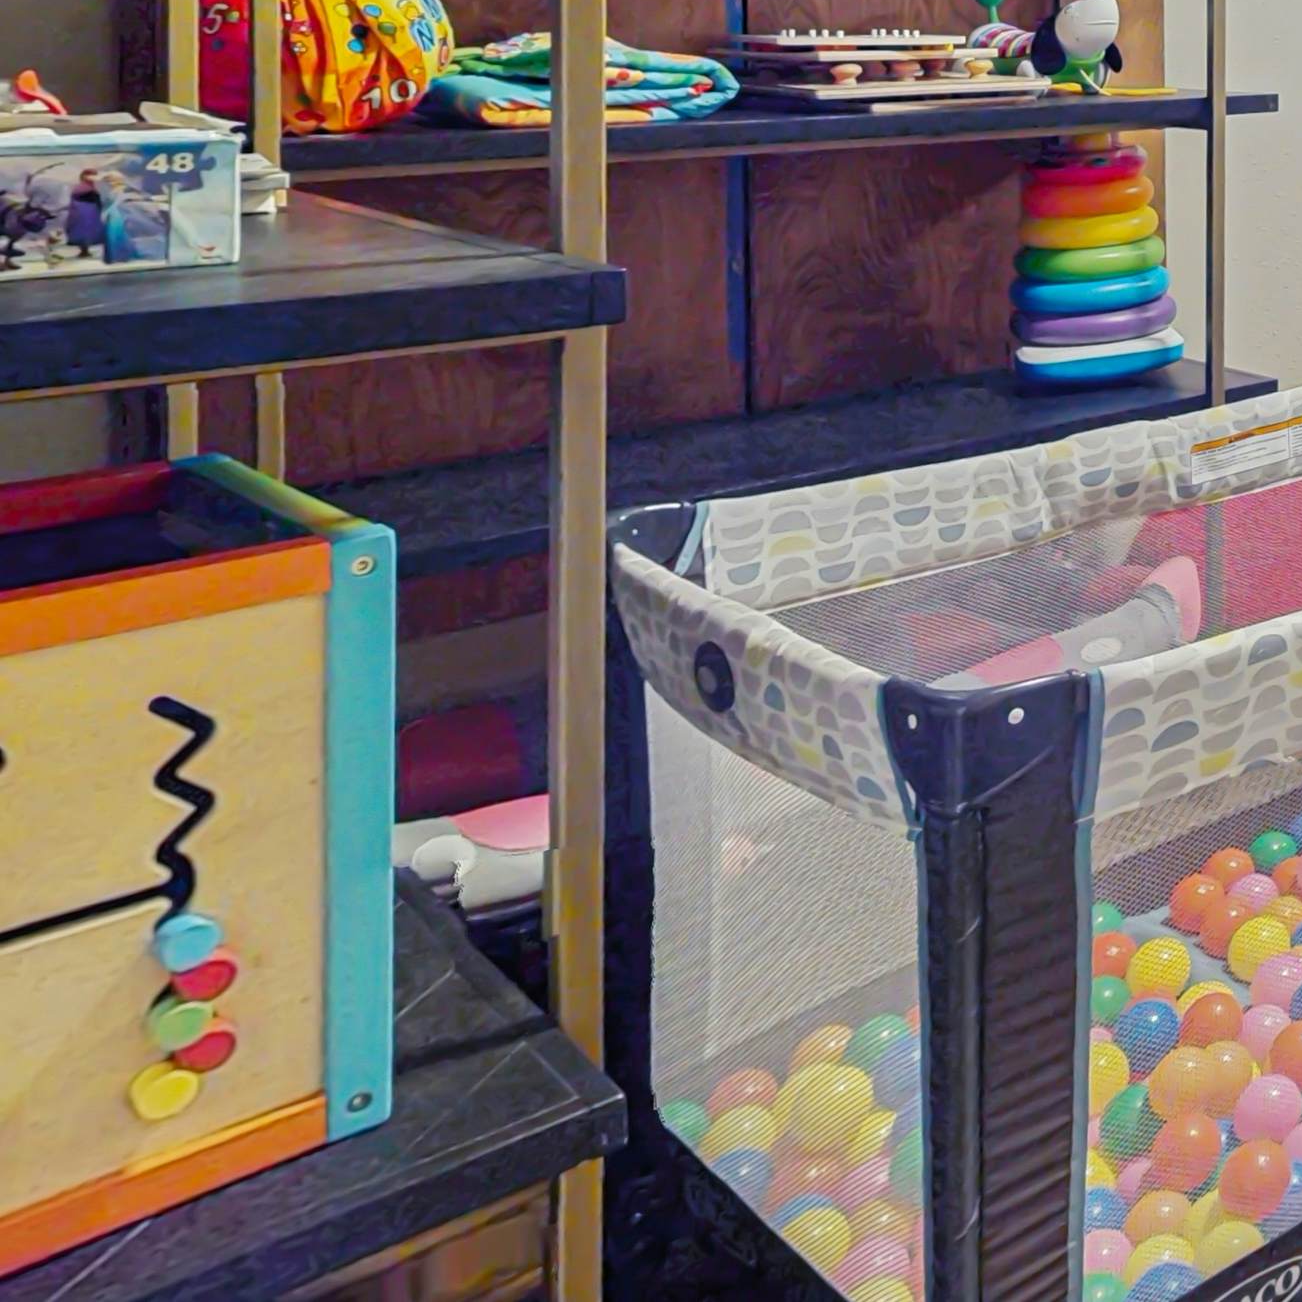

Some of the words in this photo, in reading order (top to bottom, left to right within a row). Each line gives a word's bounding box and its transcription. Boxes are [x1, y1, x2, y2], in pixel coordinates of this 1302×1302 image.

[202, 3, 229, 34] 5
[361, 78, 418, 110] 10
[146, 152, 195, 174] 48
